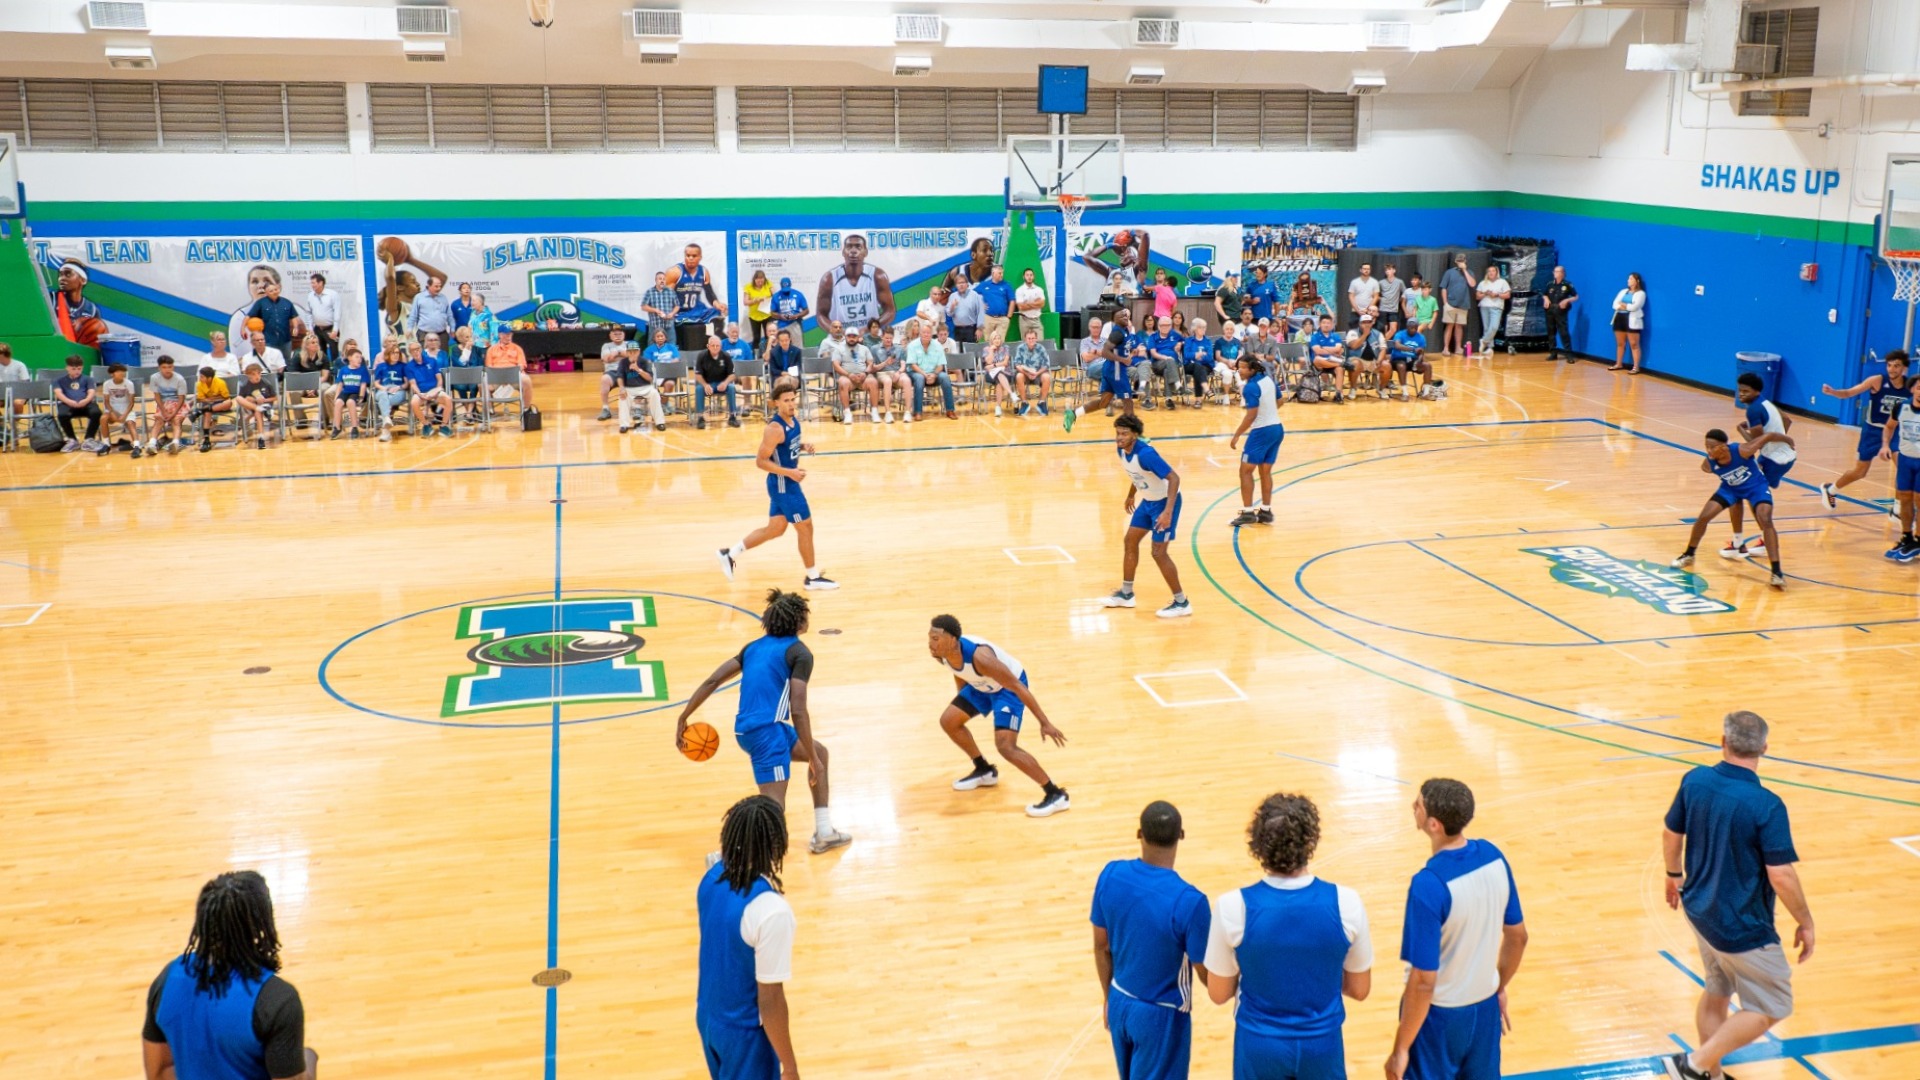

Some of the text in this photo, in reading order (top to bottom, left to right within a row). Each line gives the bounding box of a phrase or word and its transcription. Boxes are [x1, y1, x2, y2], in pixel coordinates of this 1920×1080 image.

[1700, 163, 1840, 195] SHAKAS UP
[85, 240, 151, 263] LEAN
[186, 238, 358, 263] ACKNOWLEDGE
[739, 231, 842, 251] CHARACTER
[866, 230, 968, 249] TOUGHNESS
[482, 236, 627, 274] ISLANDERS
[682, 293, 698, 309] 10
[847, 304, 867, 319] 54
[1533, 546, 1730, 614] SOUTHLAND
